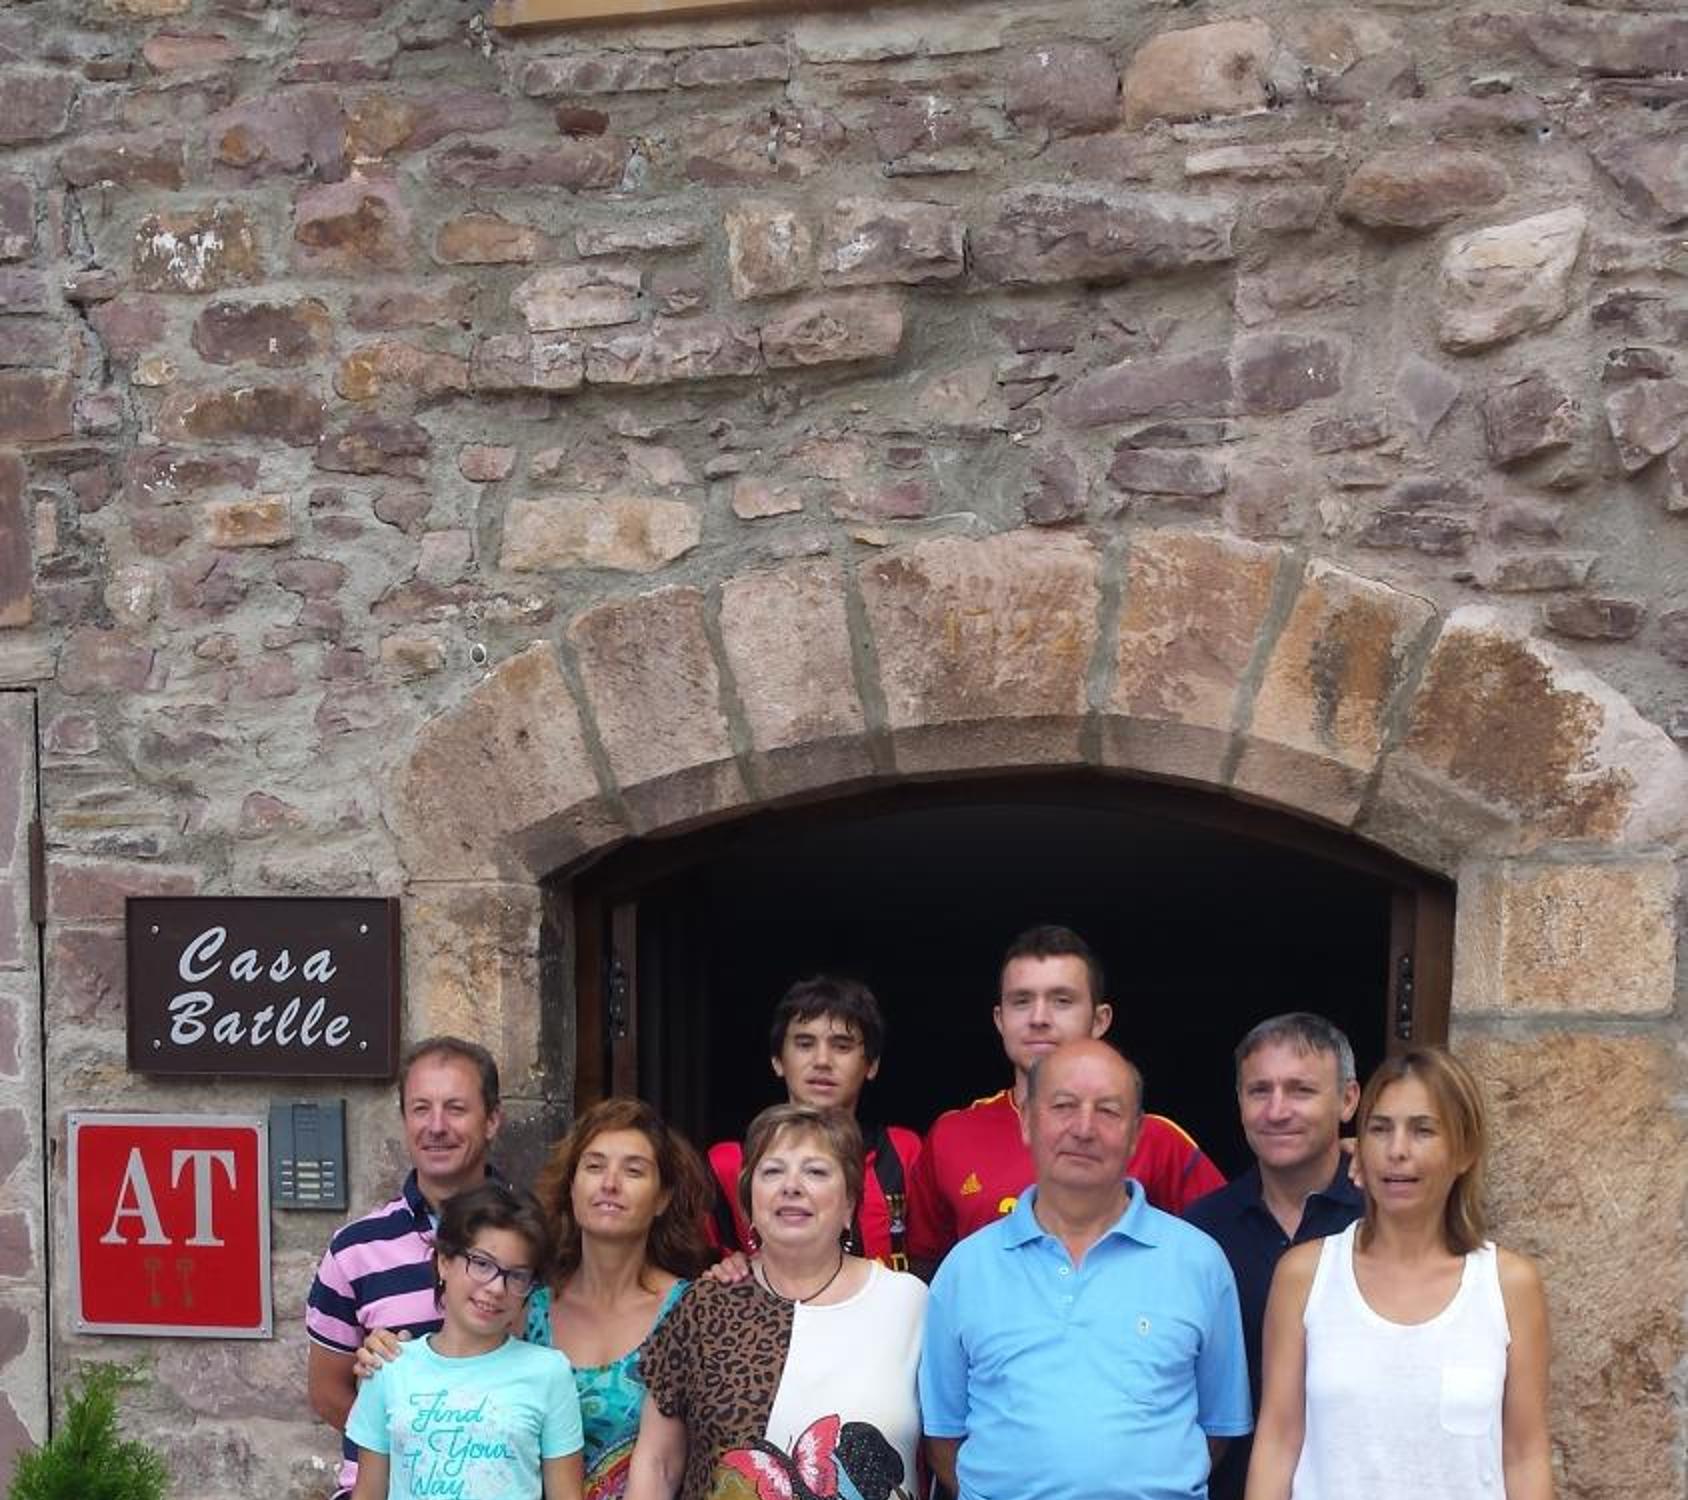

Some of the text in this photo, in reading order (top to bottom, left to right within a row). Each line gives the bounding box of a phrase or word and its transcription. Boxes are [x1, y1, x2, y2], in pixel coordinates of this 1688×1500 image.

[178, 926, 337, 983] Casa
[167, 990, 352, 1047] Batlle
[100, 1147, 237, 1247] AT
[409, 1389, 489, 1433] Find
[428, 1426, 517, 1477] Your
